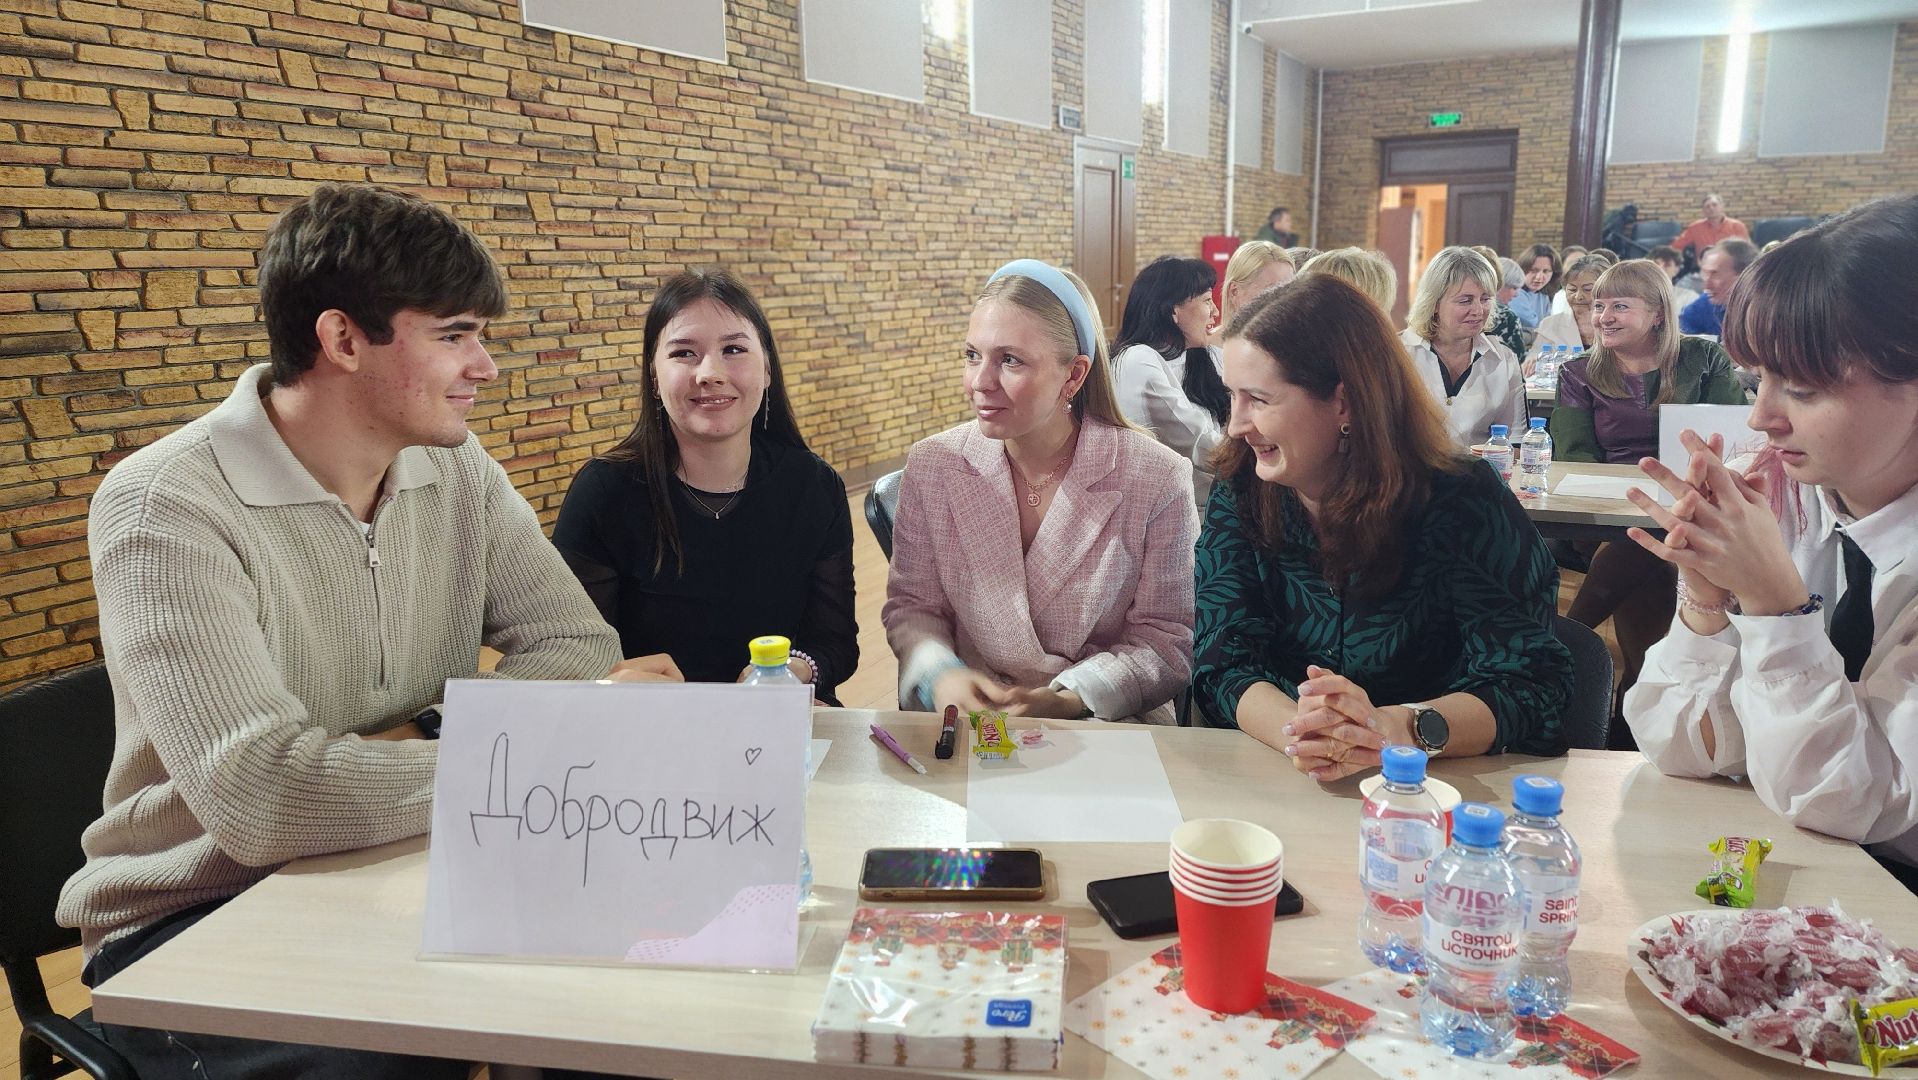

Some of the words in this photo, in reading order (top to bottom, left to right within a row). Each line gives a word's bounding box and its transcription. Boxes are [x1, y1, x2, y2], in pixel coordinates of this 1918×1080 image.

[469, 731, 777, 888] Добродвиж
[1538, 909, 1578, 924] SPRIN
[1451, 929, 1512, 947] СВЯТОЙ
[1441, 938, 1518, 961] ИСТОЧНИК
